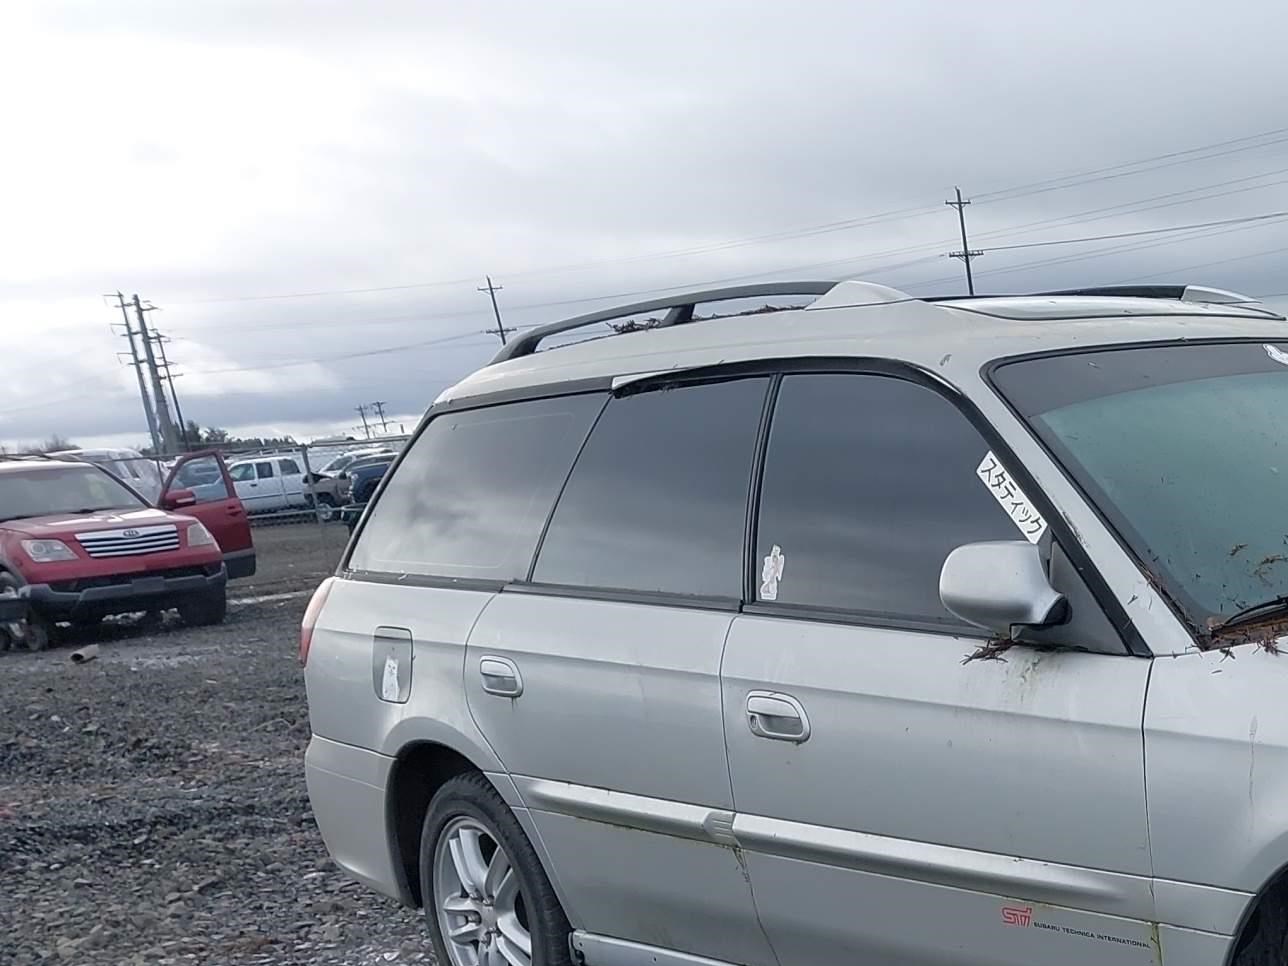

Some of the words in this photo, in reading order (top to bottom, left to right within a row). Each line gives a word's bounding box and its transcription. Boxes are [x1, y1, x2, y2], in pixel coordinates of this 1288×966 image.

[1033, 921, 1061, 932] SUBARU
[1062, 926, 1095, 939] TECHNICA
[1096, 934, 1151, 949] INTERNATIONAL
